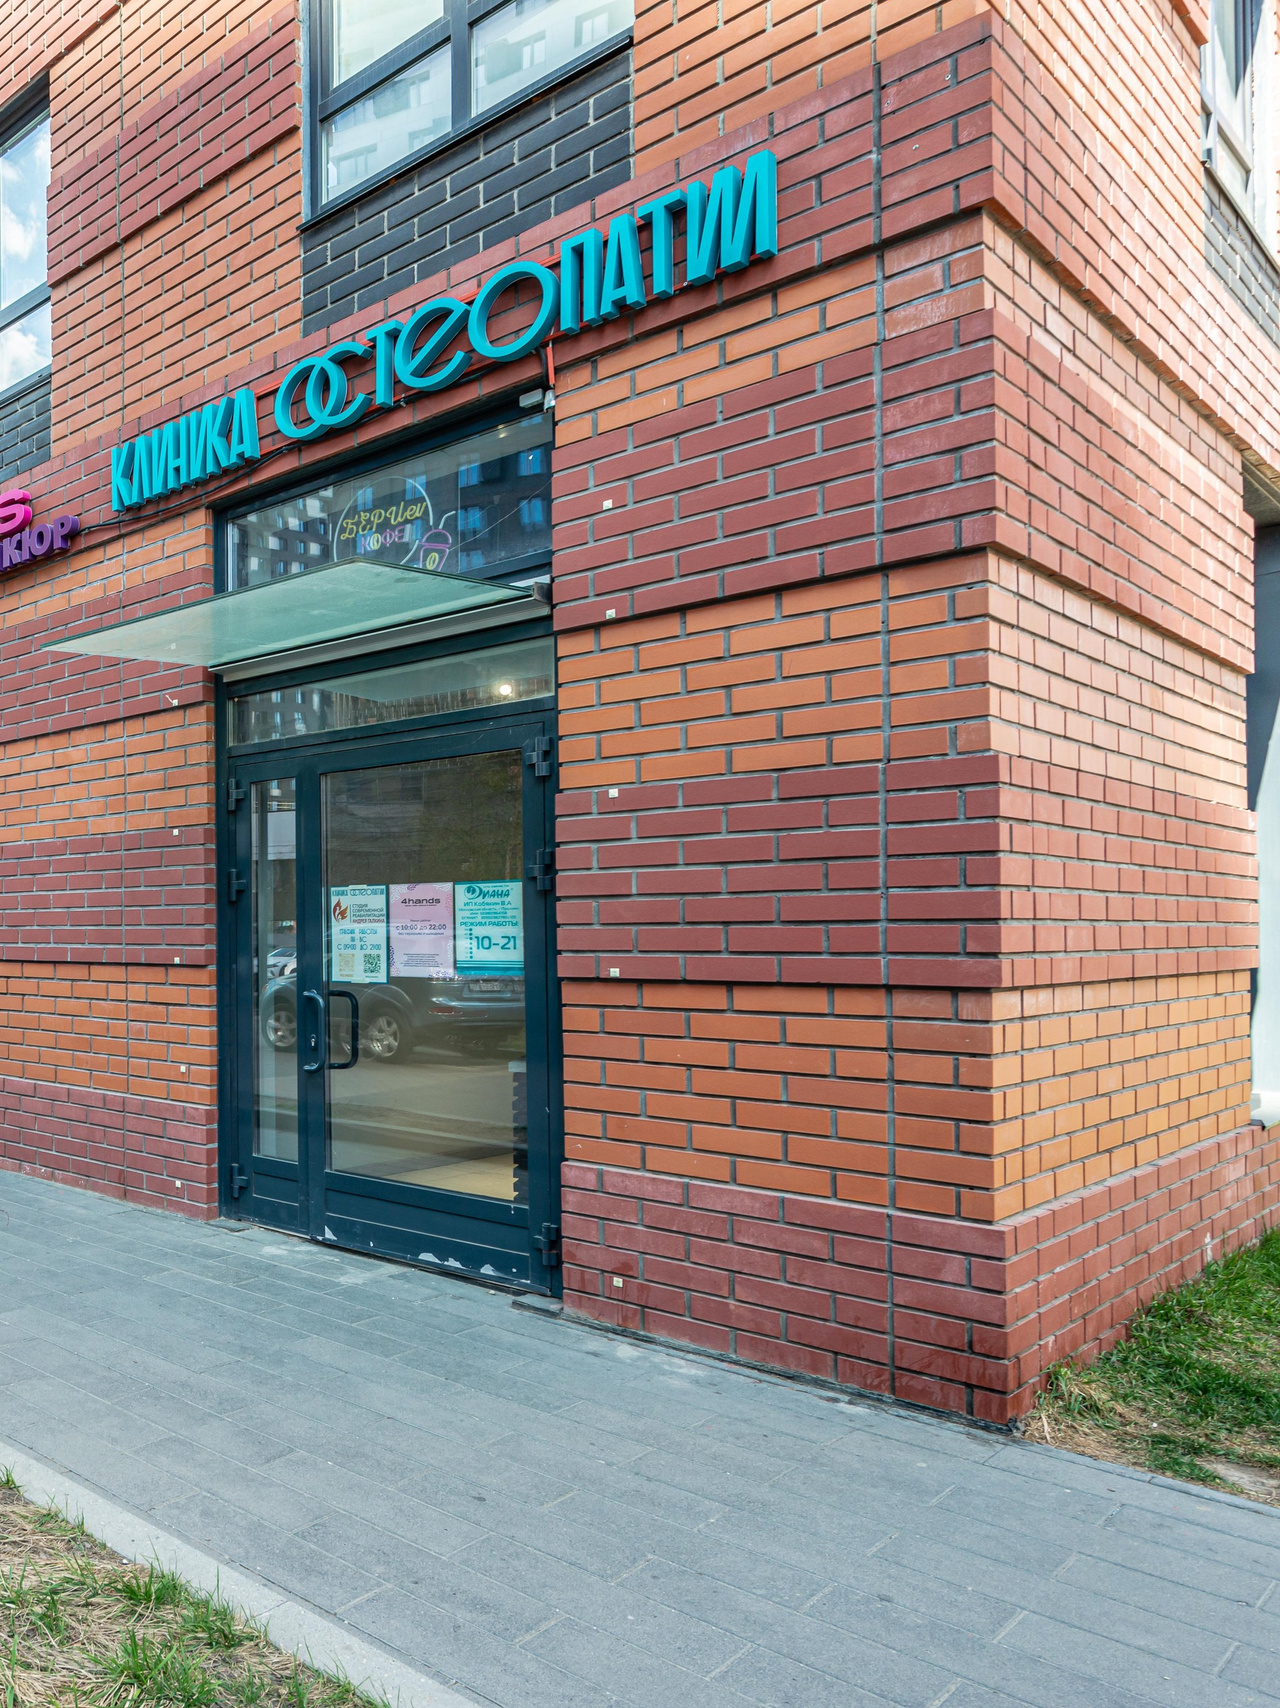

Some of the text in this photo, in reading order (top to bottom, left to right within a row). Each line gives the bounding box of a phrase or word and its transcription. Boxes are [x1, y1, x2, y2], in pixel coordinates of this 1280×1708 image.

[111, 388, 261, 513] КЛИНИКА
[361, 525, 405, 555] КОФЕ
[464, 884, 510, 900] ДИАНА
[401, 897, 441, 905] 4hands
[428, 923, 447, 931] 22:00
[360, 943, 368, 951] ДО
[474, 935, 517, 950] 10-21
